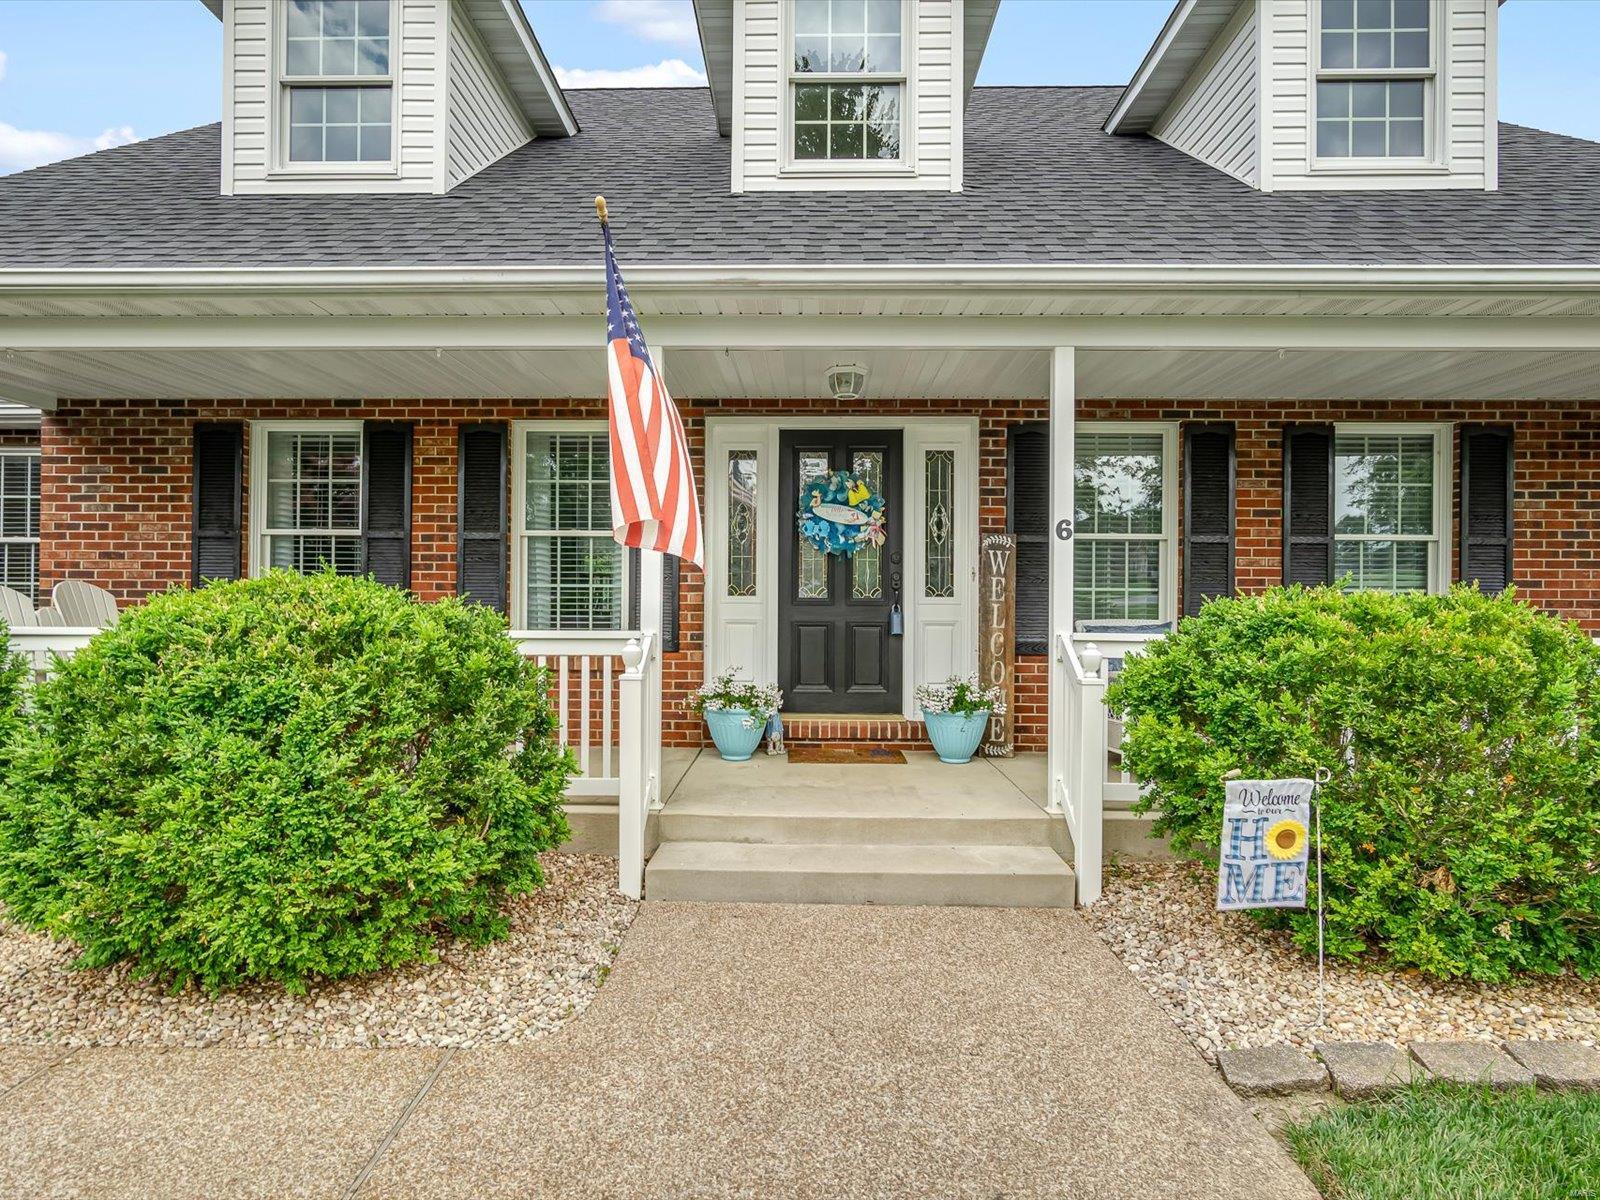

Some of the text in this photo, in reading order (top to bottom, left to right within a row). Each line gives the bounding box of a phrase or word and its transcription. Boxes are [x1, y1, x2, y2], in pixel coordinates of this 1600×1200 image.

[1056, 519, 1073, 541] 6
[1238, 788, 1301, 807] Welcome
[1257, 807, 1265, 815] to
